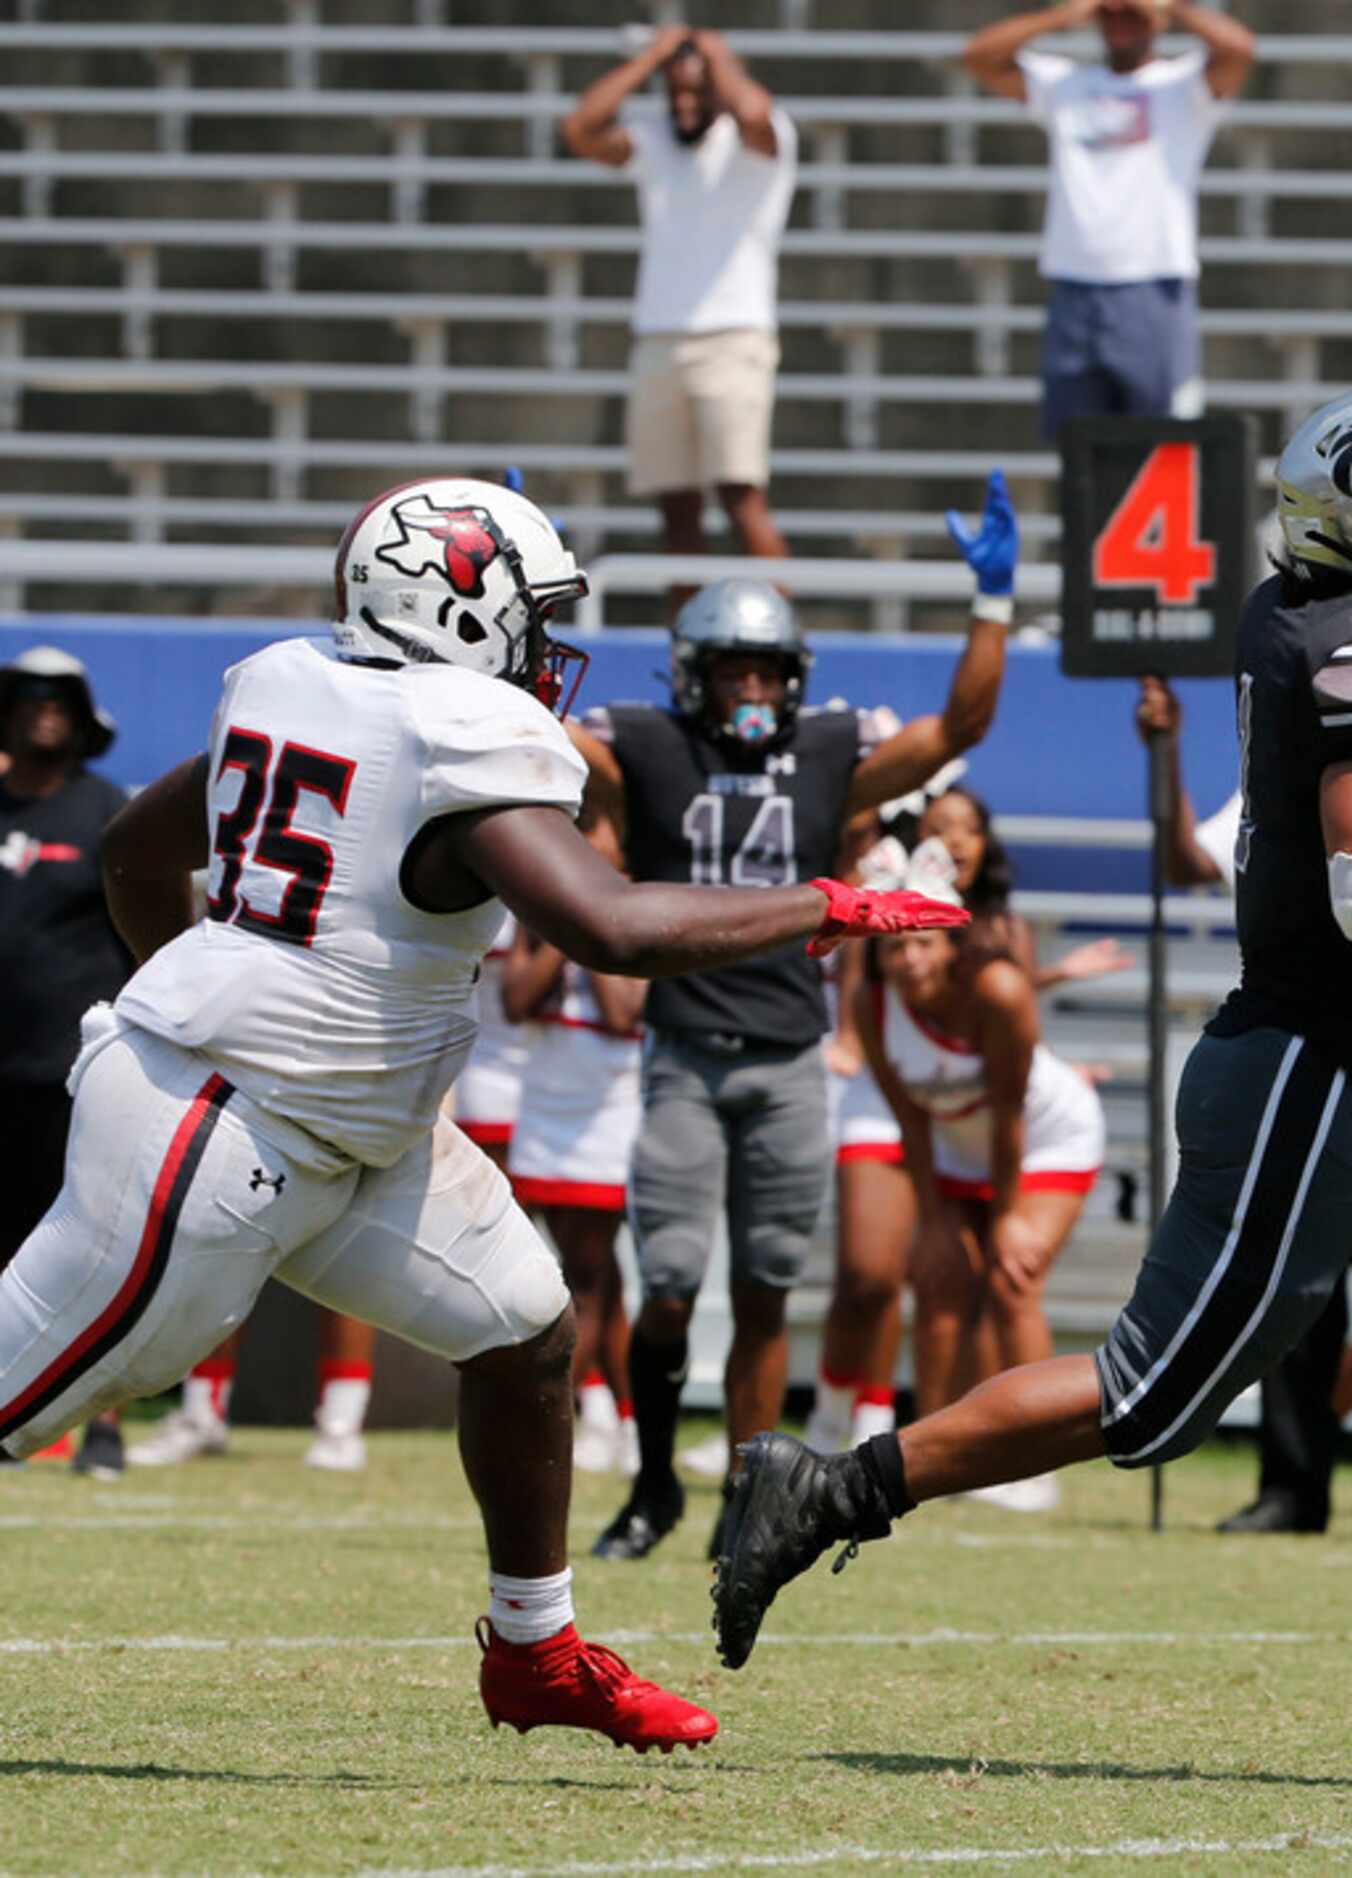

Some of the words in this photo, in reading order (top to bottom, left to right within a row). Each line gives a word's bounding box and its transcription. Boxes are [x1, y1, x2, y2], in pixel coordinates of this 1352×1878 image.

[1092, 439, 1216, 605] 4
[207, 724, 358, 949] 35
[682, 793, 797, 886] 14
